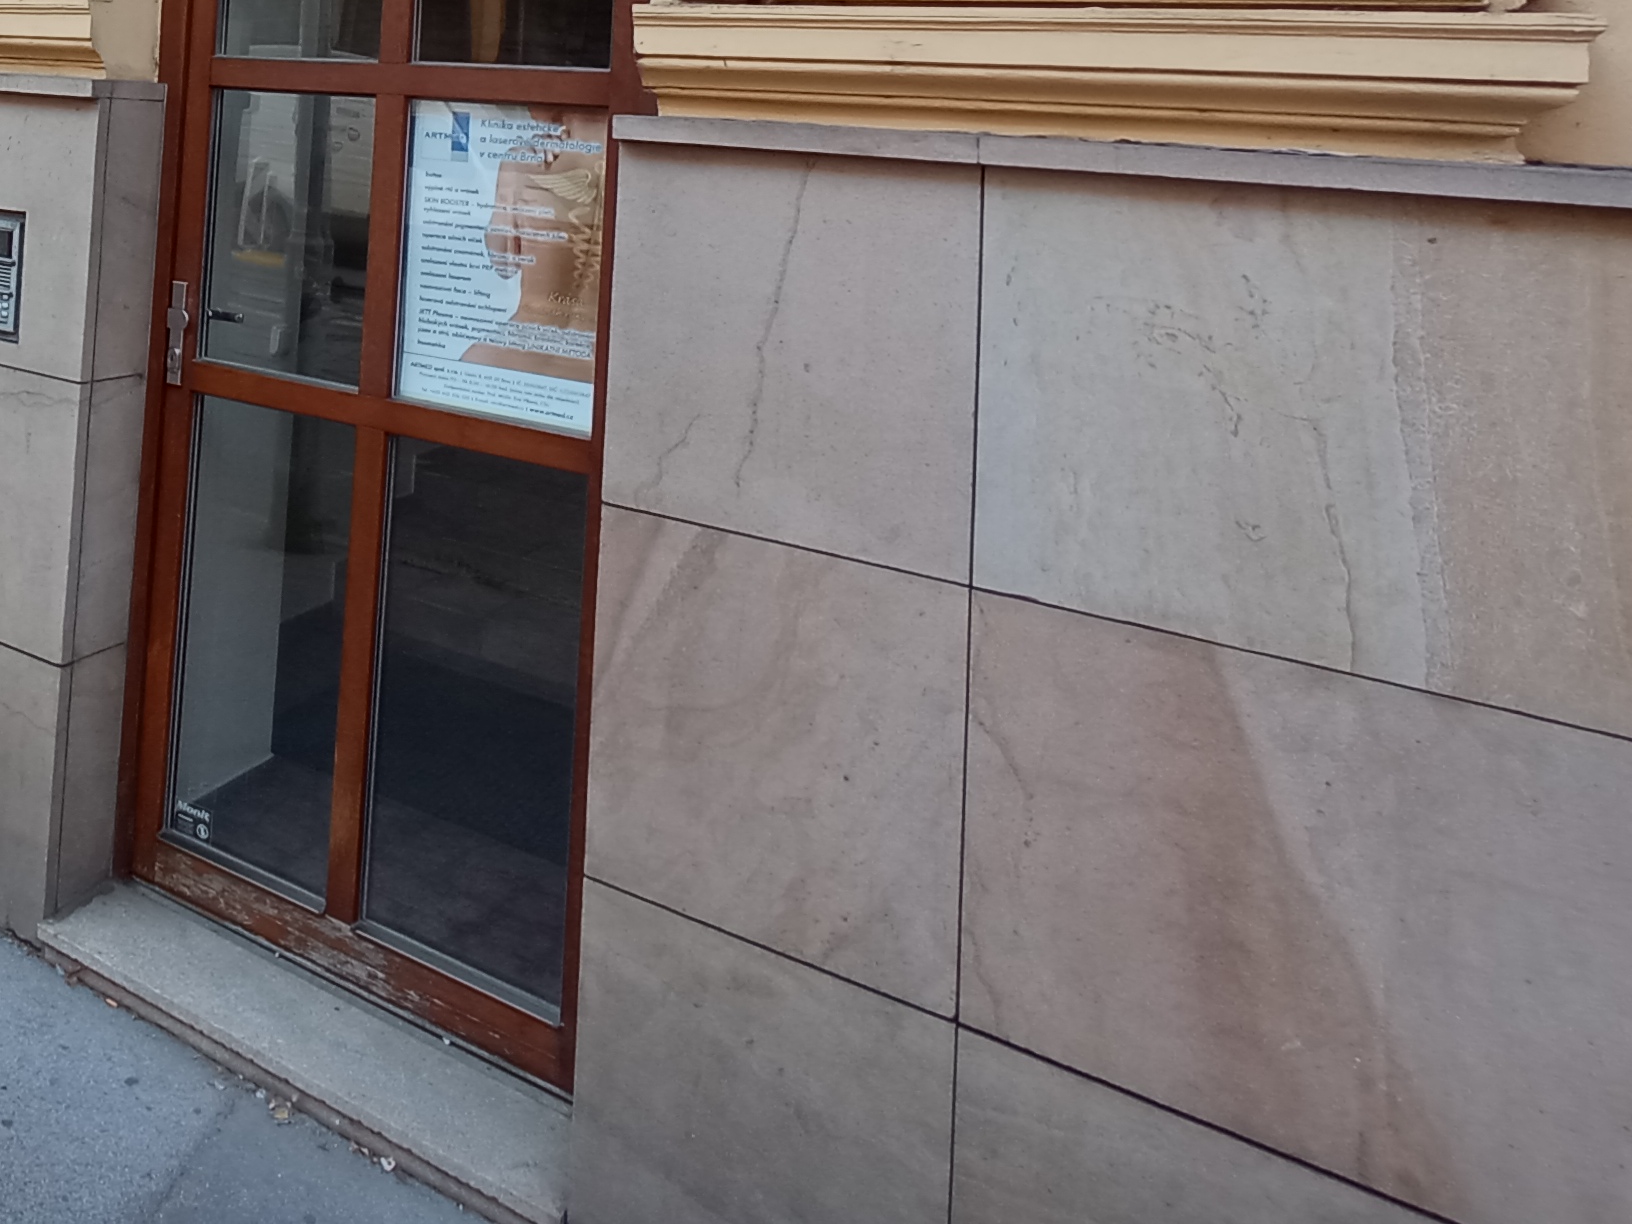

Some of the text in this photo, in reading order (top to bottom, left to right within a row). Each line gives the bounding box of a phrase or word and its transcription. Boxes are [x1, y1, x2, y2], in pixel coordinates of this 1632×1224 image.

[480, 118, 514, 131] Klinika
[533, 135, 603, 155] dermatologie
[487, 151, 518, 162] centru
